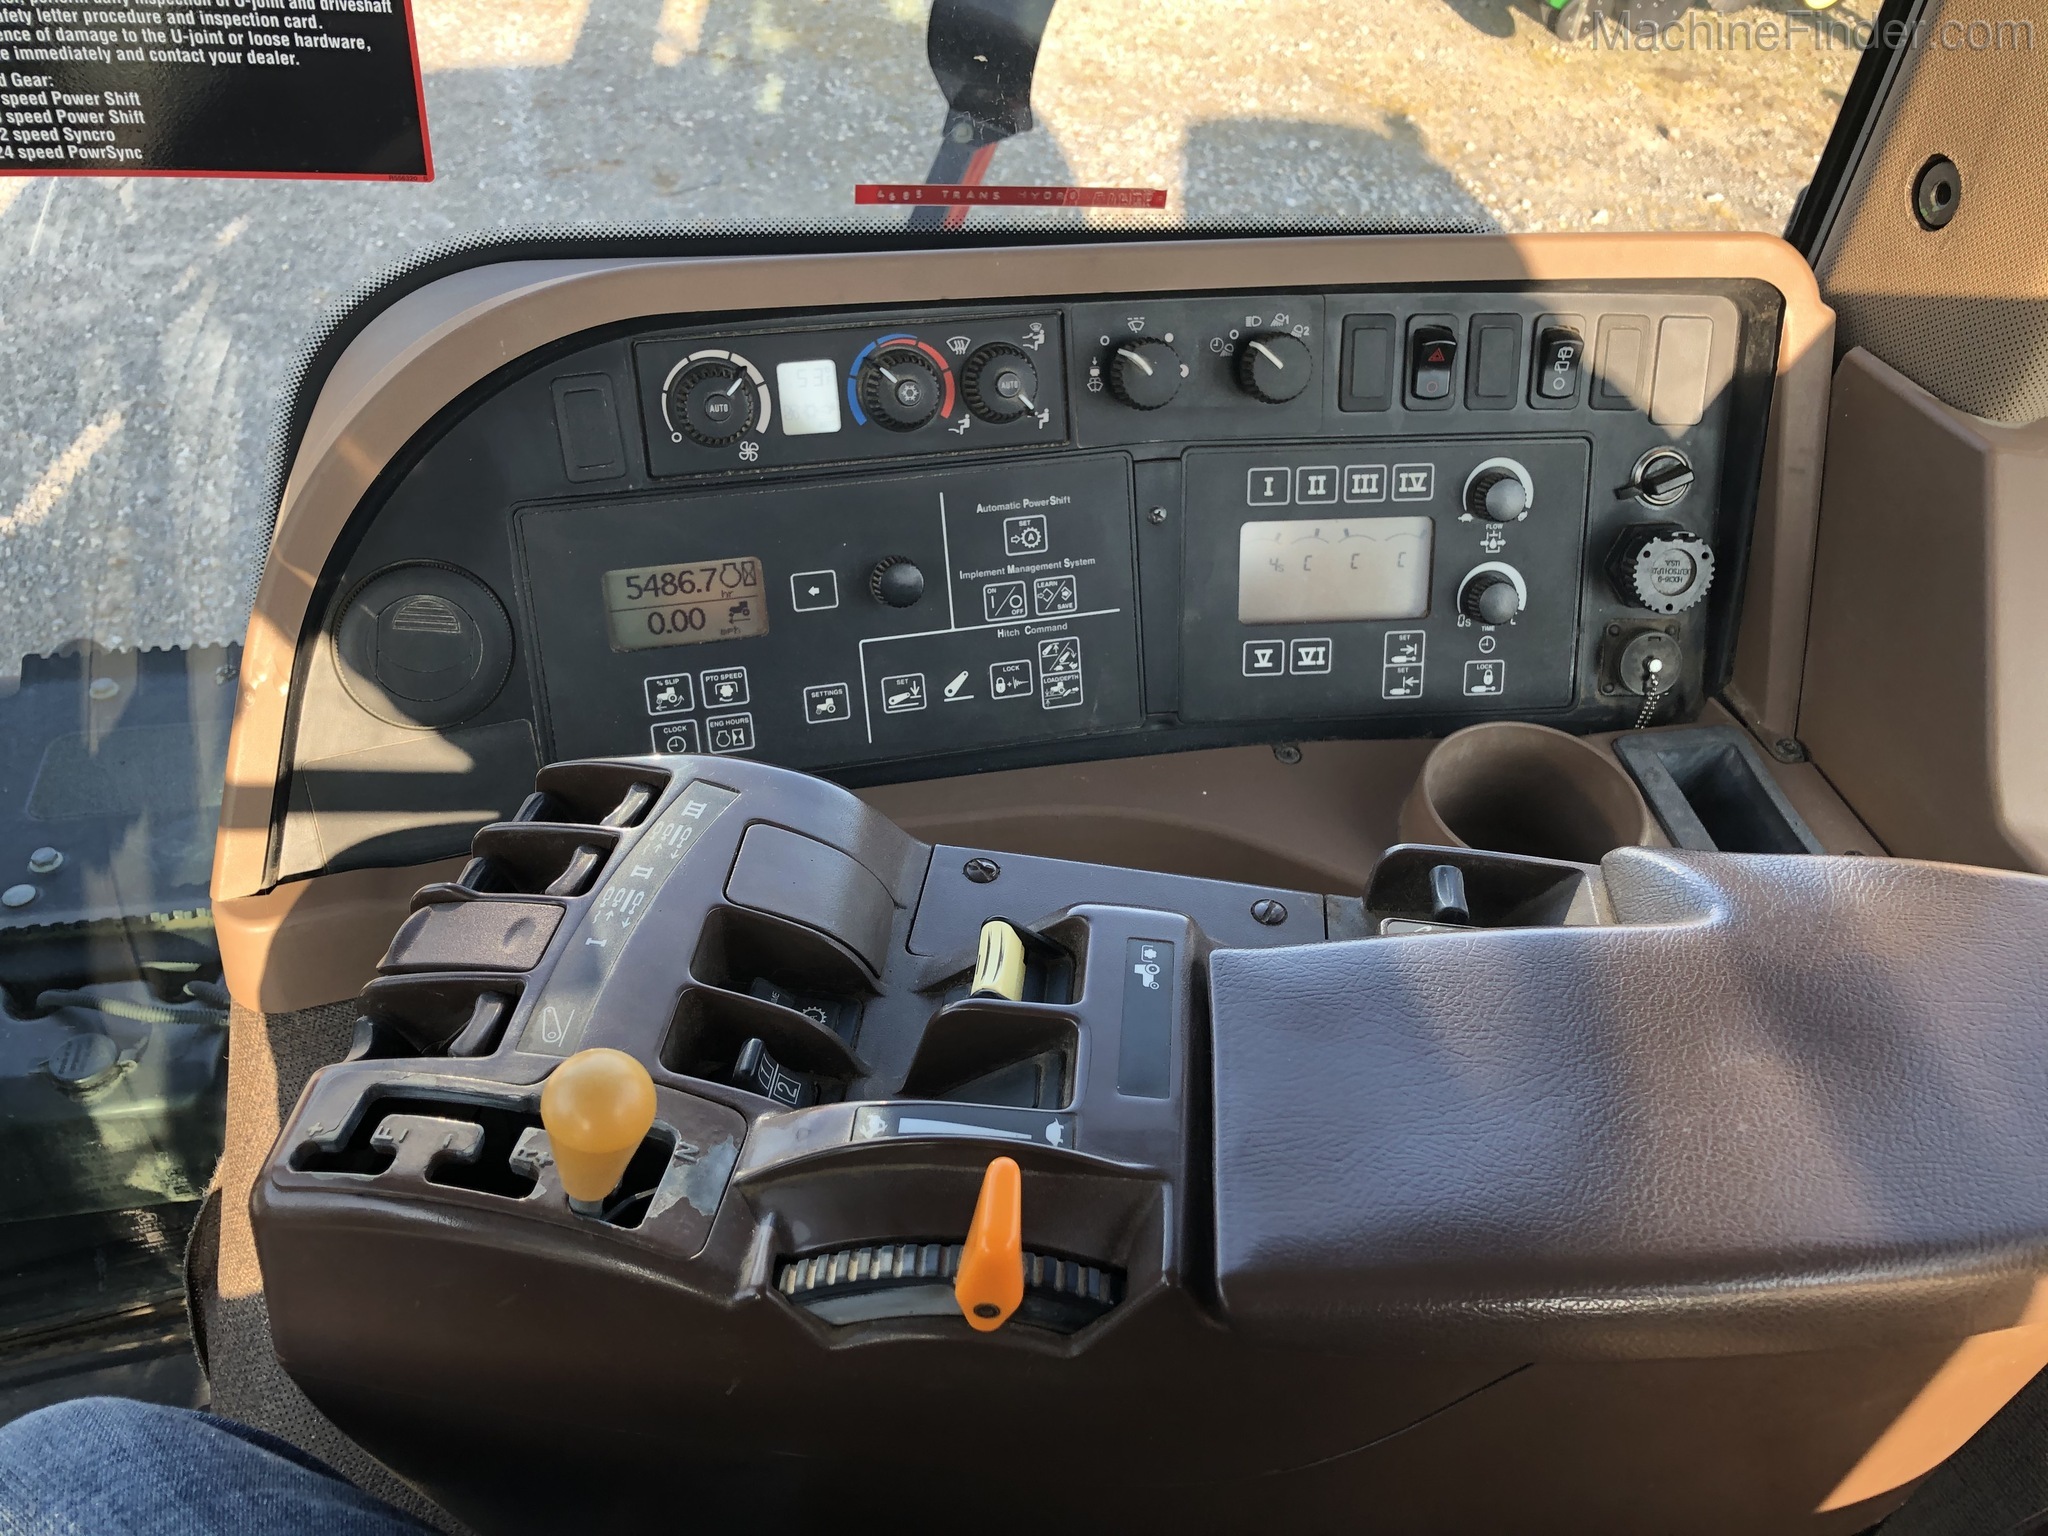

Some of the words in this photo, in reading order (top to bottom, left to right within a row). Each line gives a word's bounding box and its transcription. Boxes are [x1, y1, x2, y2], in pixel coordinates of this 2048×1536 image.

[289, 0, 315, 11] and
[320, 0, 392, 14] driveshaft
[36, 7, 78, 23] letter
[83, 9, 162, 26] procedure
[166, 9, 196, 25] and
[199, 10, 280, 29] inspection
[284, 13, 323, 30] card.
[35, 27, 51, 42] of
[55, 27, 118, 45] damage
[122, 28, 138, 43] to
[142, 28, 167, 43] the
[171, 28, 225, 48] U-joint
[228, 32, 244, 46] or
[248, 30, 290, 47] loose
[294, 31, 372, 52] hardware,
[13, 46, 112, 64] immediately
[116, 47, 145, 62] and
[149, 47, 206, 63] contact
[209, 51, 243, 66] your
[247, 49, 301, 66] dealer.
[10, 72, 54, 88] Gear:
[1, 91, 49, 108] speed
[50, 91, 101, 106] Power
[104, 91, 142, 107] Shift
[6, 109, 53, 127] speed
[55, 109, 105, 124] Power
[109, 109, 146, 125] Shift
[13, 127, 61, 145] speed
[63, 126, 116, 144] Syncro
[17, 145, 65, 163] speed
[66, 144, 143, 163] PowrSync
[941, 189, 1001, 200] TRANS
[1001, 380, 1019, 389] AUTO
[709, 403, 729, 413] AUTO
[1351, 473, 1379, 494] III
[1399, 472, 1428, 493] IV
[976, 501, 1021, 513] Automatic
[1022, 495, 1071, 509] PowerShift
[1018, 519, 1031, 527] SET
[959, 569, 1006, 580] Implement
[1007, 562, 1062, 575] Management
[1063, 557, 1096, 569] System
[625, 567, 717, 600] 5486.7
[1037, 580, 1058, 589] LEARN
[1011, 608, 1024, 616] OFF
[1057, 602, 1073, 610] SAVE
[647, 607, 706, 635] 0.00
[997, 627, 1020, 639] Hitch
[1025, 622, 1068, 635] Command
[1002, 665, 1021, 673] LOCK
[1476, 663, 1493, 671] LOCK
[664, 677, 680, 686] SLIP
[720, 672, 743, 681] SPEED
[896, 678, 909, 686] SET
[1043, 674, 1079, 685] LOAD/DEPTH
[811, 688, 843, 698] SETTINGS
[709, 721, 724, 729] ENG
[725, 716, 750, 726] HOURS
[663, 725, 687, 734] CLOCK
